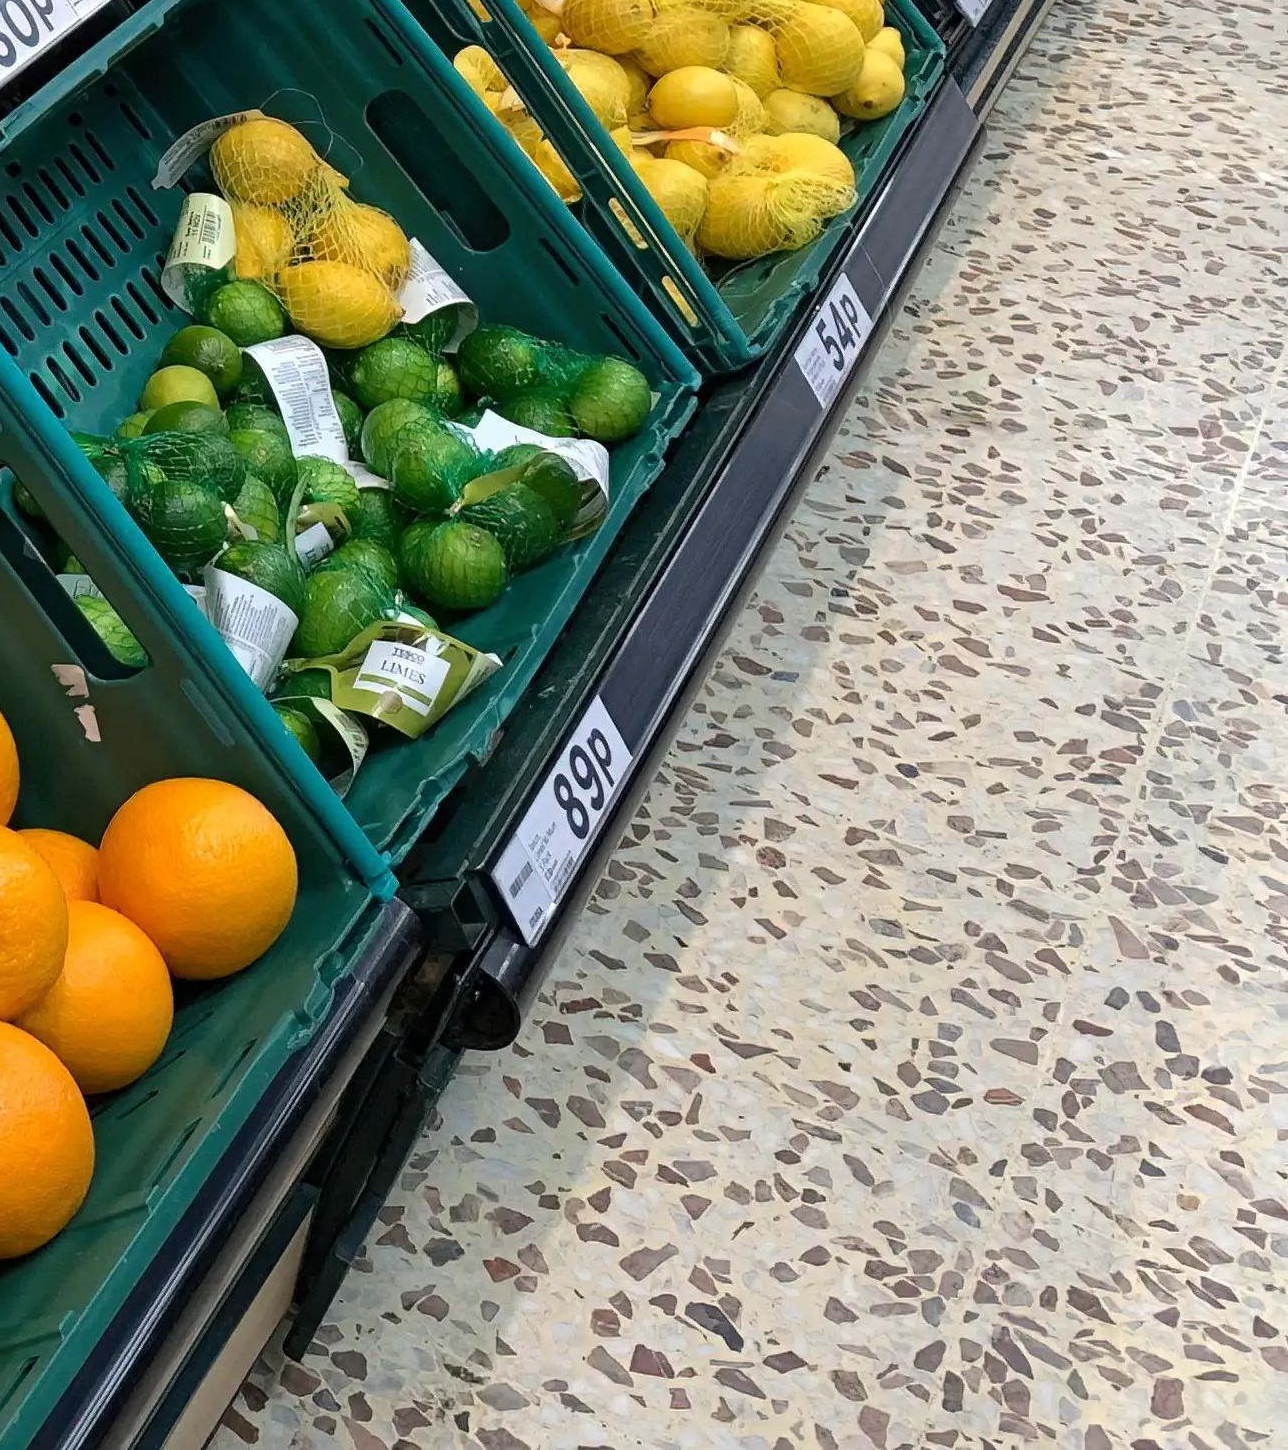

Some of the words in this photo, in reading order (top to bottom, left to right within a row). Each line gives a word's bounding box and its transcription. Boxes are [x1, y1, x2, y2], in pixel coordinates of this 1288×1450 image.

[815, 294, 861, 372] 54p
[380, 659, 427, 685] LIMES
[391, 646, 425, 666] TESCO
[553, 727, 616, 840] 89p
